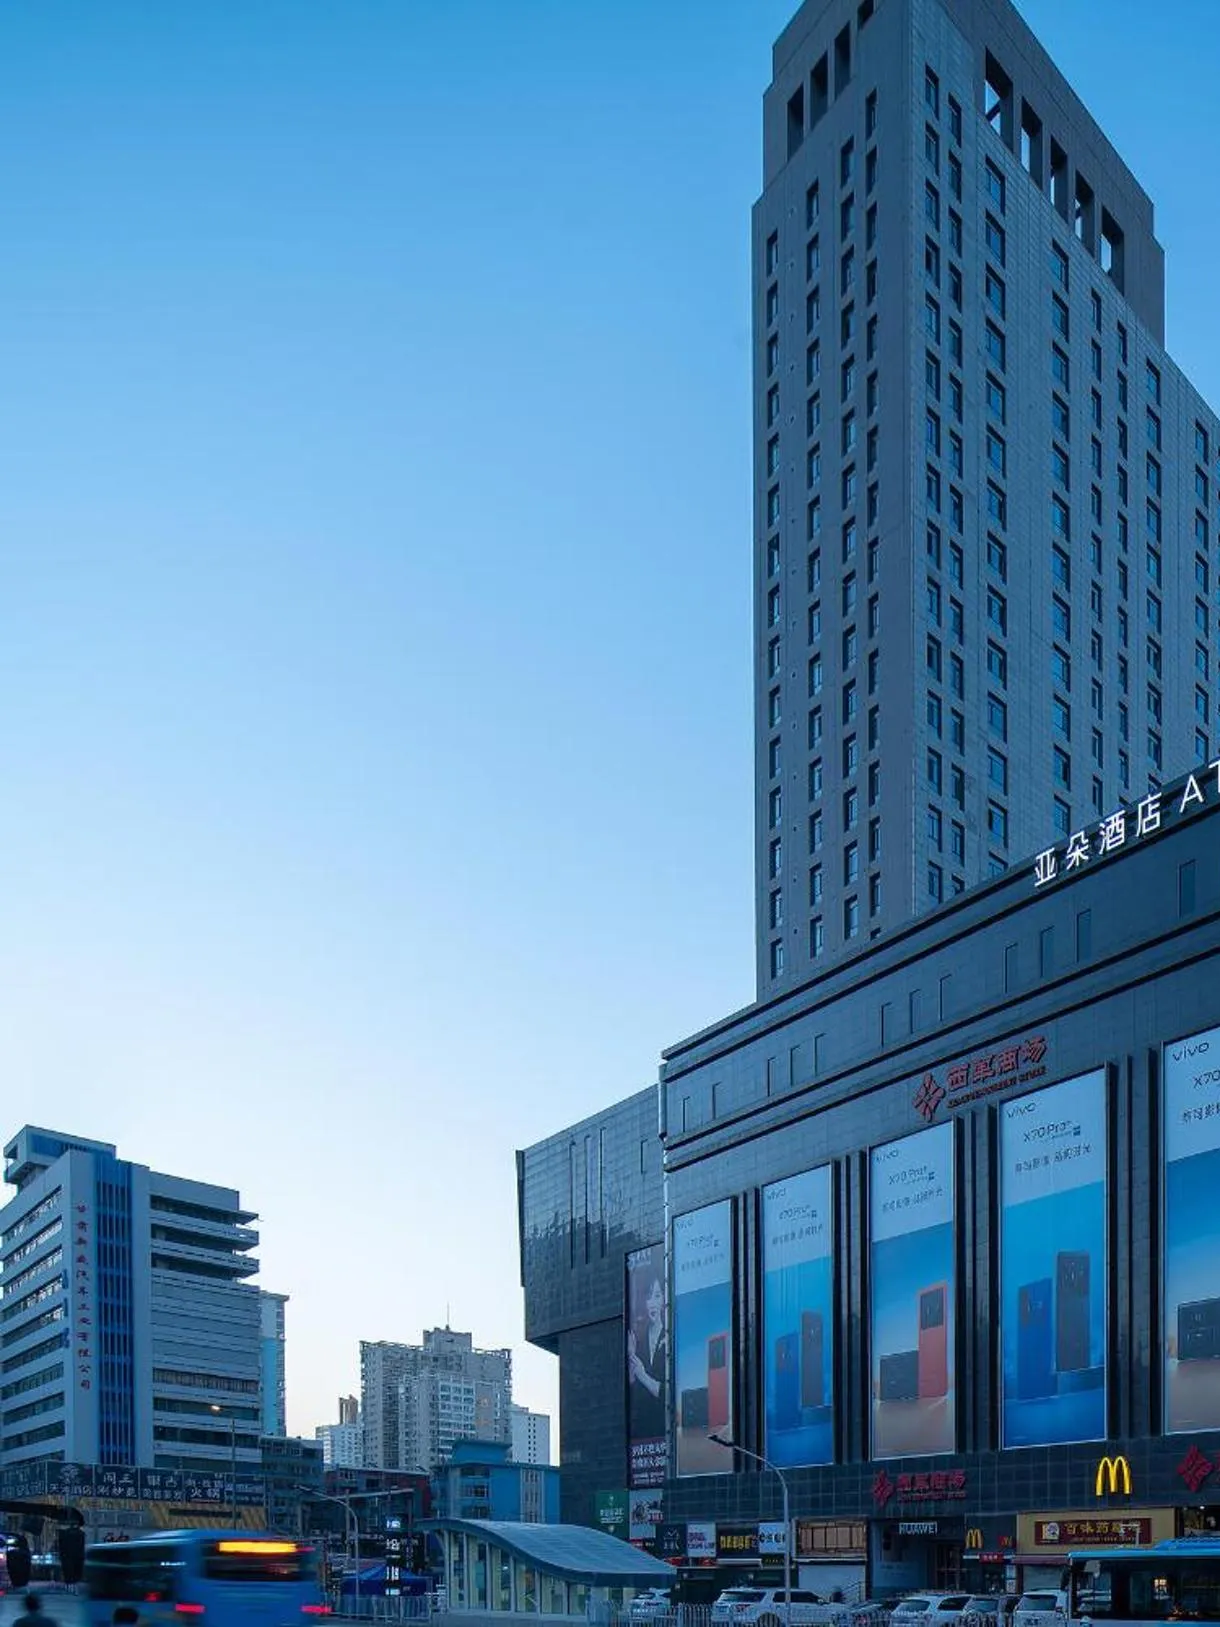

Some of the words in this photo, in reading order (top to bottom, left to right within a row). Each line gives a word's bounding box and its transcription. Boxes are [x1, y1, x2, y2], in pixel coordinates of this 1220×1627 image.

[1033, 792, 1163, 888] 亚朵酒店
[1172, 1042, 1210, 1061] vivo
